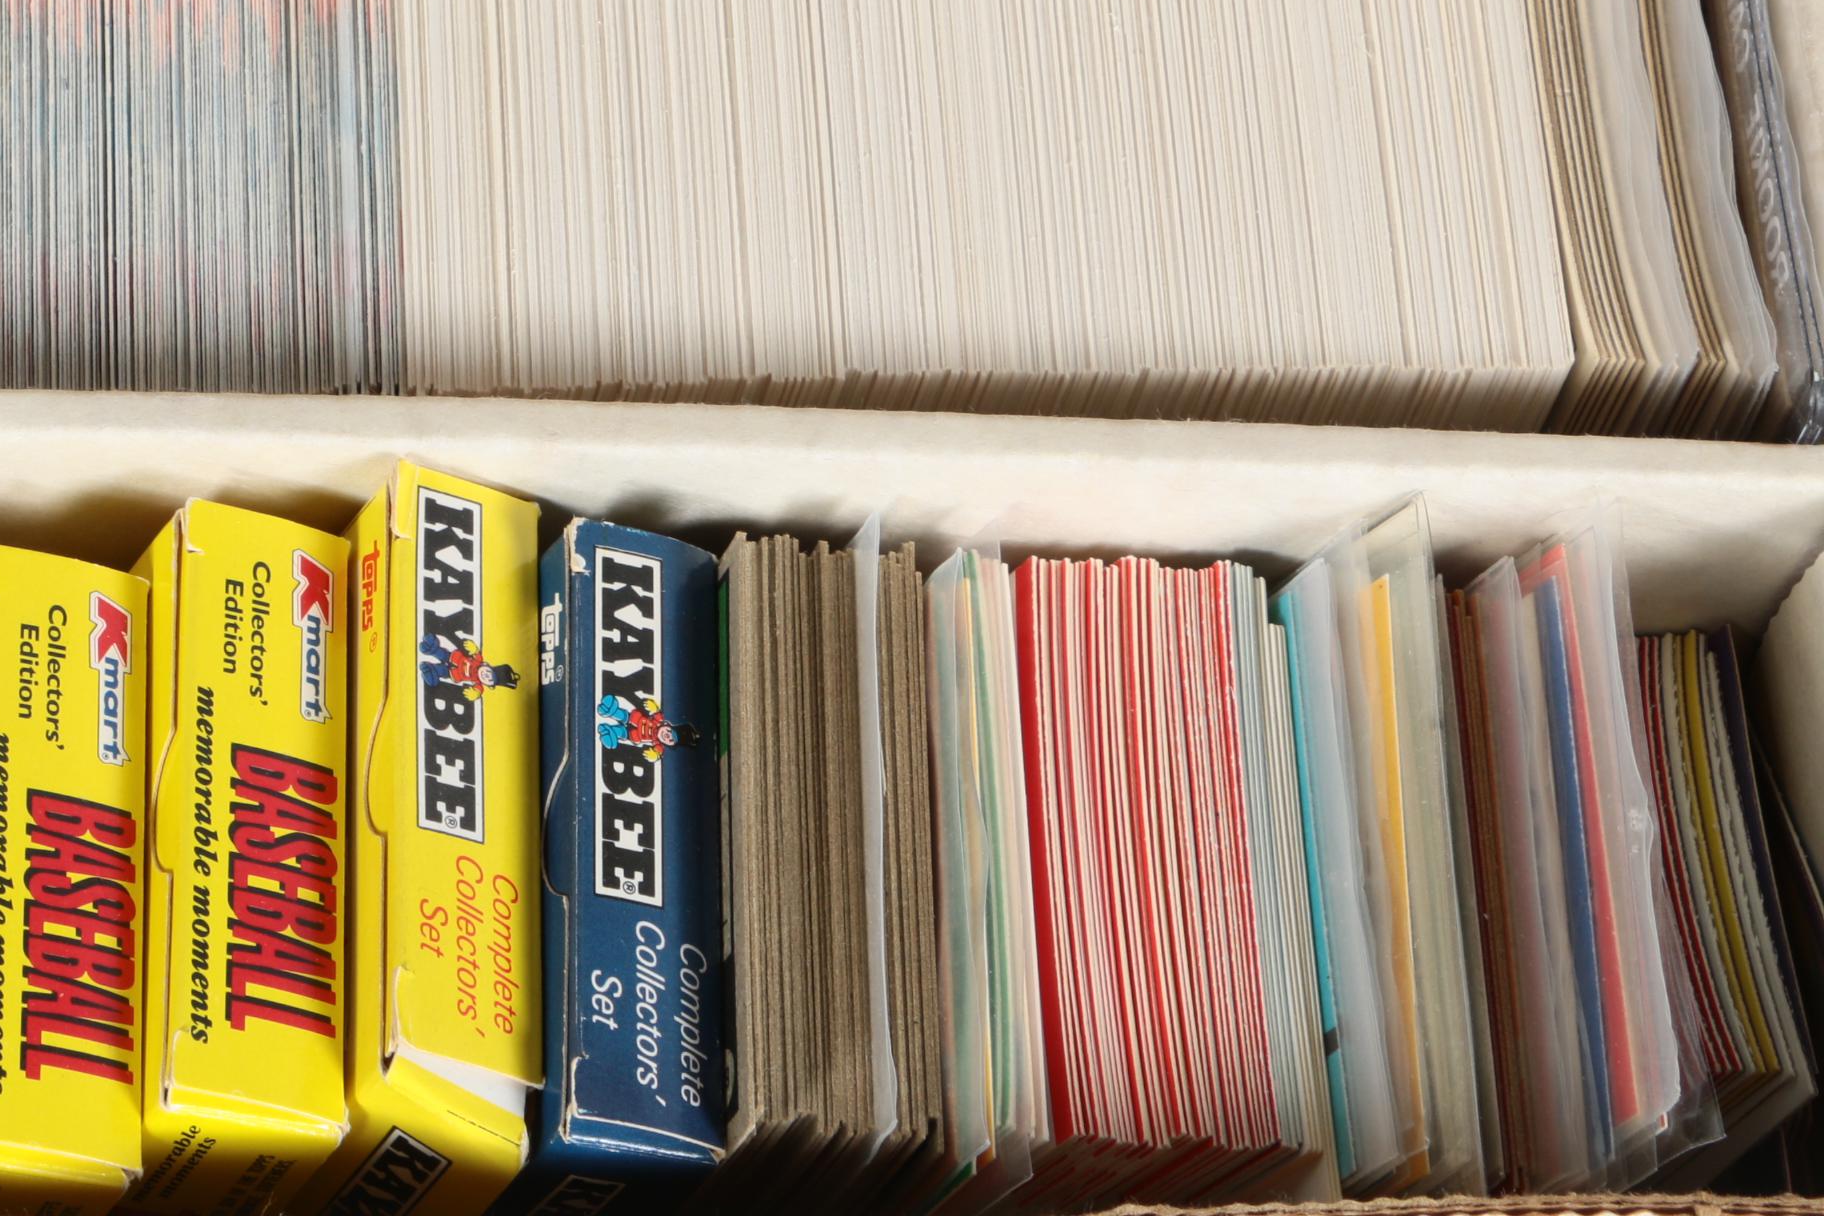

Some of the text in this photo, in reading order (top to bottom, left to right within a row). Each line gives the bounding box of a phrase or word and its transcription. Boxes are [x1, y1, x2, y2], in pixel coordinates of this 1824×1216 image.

[18, 623, 40, 719] Edition
[223, 578, 244, 674] Edition
[423, 496, 477, 833] KAY BEE
[601, 556, 656, 898] KAY BEE
[20, 787, 137, 1086] BASEBALL
[190, 685, 219, 1044] memorable moments
[225, 742, 338, 1039] BASEBALL
[419, 898, 449, 959] Set
[487, 874, 520, 1035] Complete
[590, 969, 623, 1031] Set
[673, 943, 708, 1108] Complete
